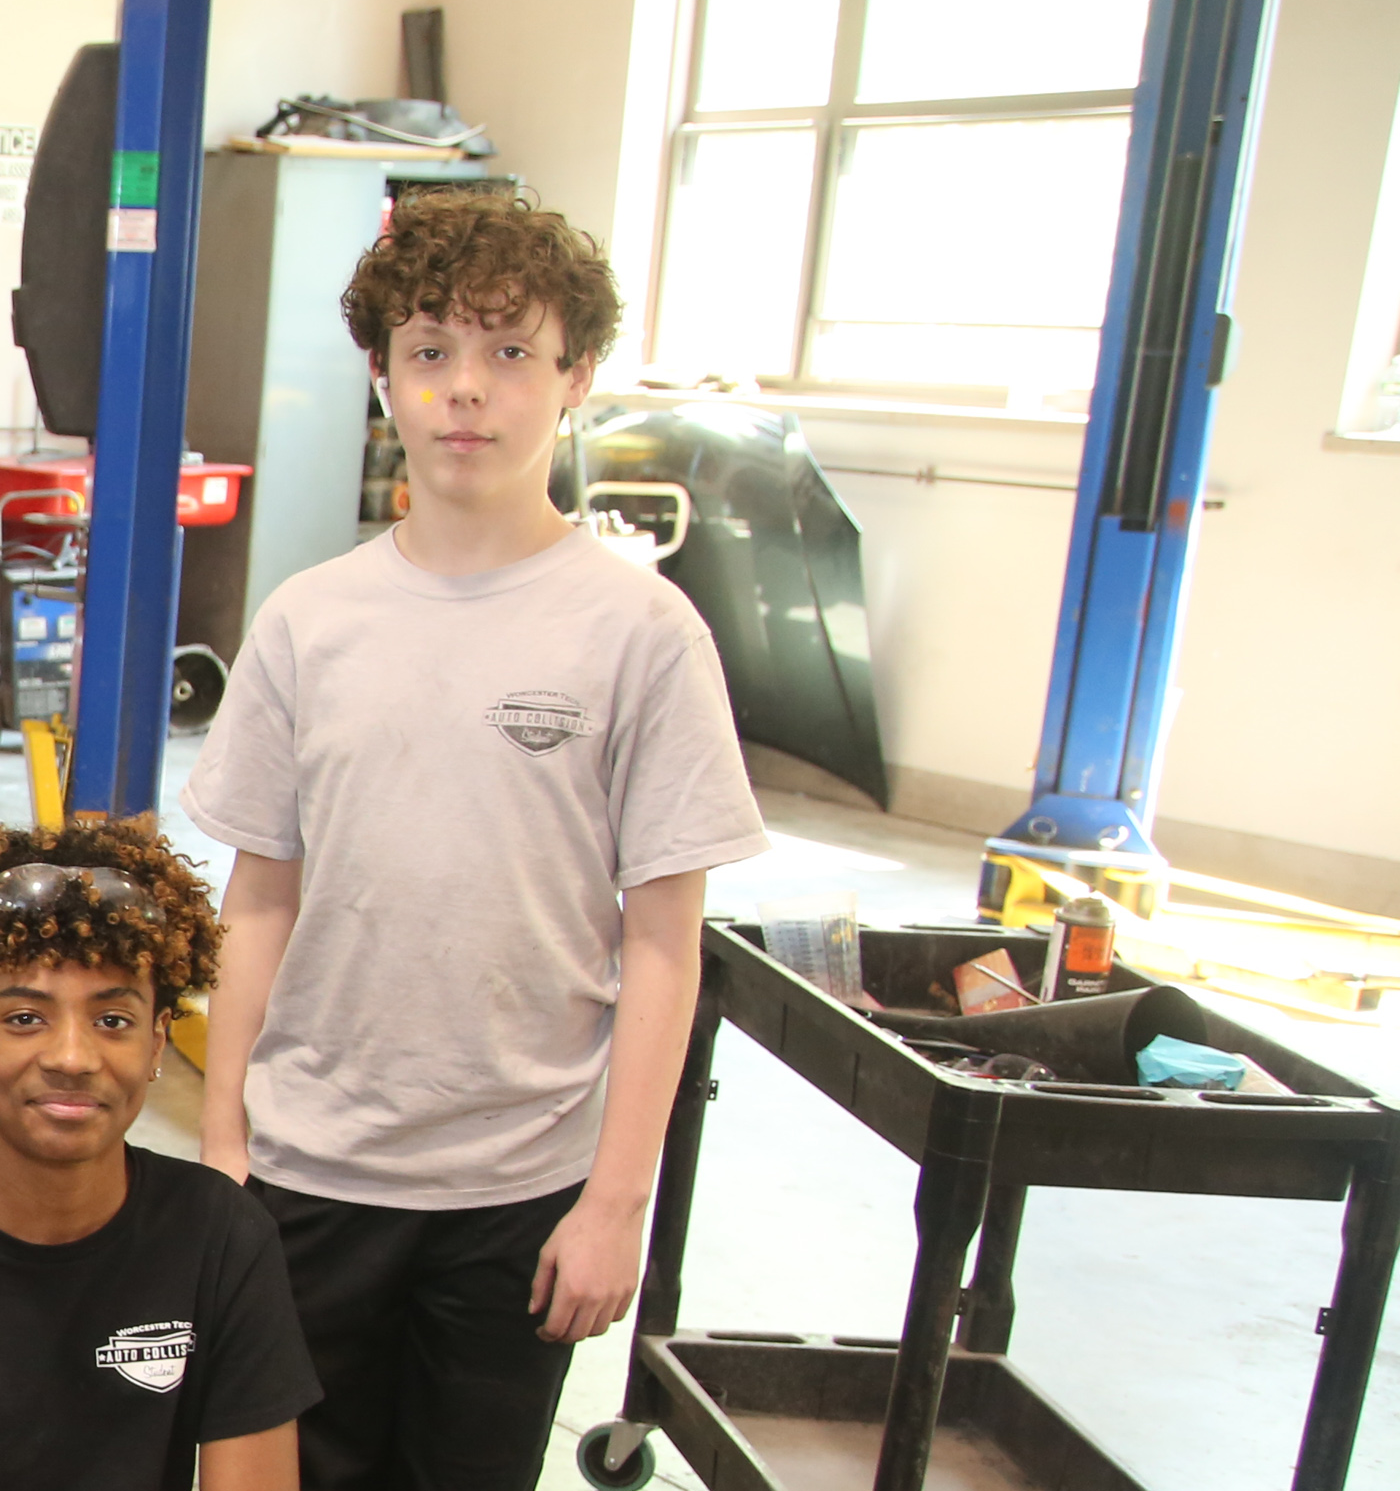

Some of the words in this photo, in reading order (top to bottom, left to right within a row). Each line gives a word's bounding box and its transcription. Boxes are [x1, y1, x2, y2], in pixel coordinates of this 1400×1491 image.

[506, 690, 558, 698] WORCESTER
[490, 712, 520, 722] AUTO
[526, 713, 585, 732] COLLISION
[116, 1322, 171, 1337] WORCESTER
[171, 1321, 193, 1330] TEC
[107, 1350, 137, 1363] AUTO
[143, 1344, 187, 1360] COLLIS
